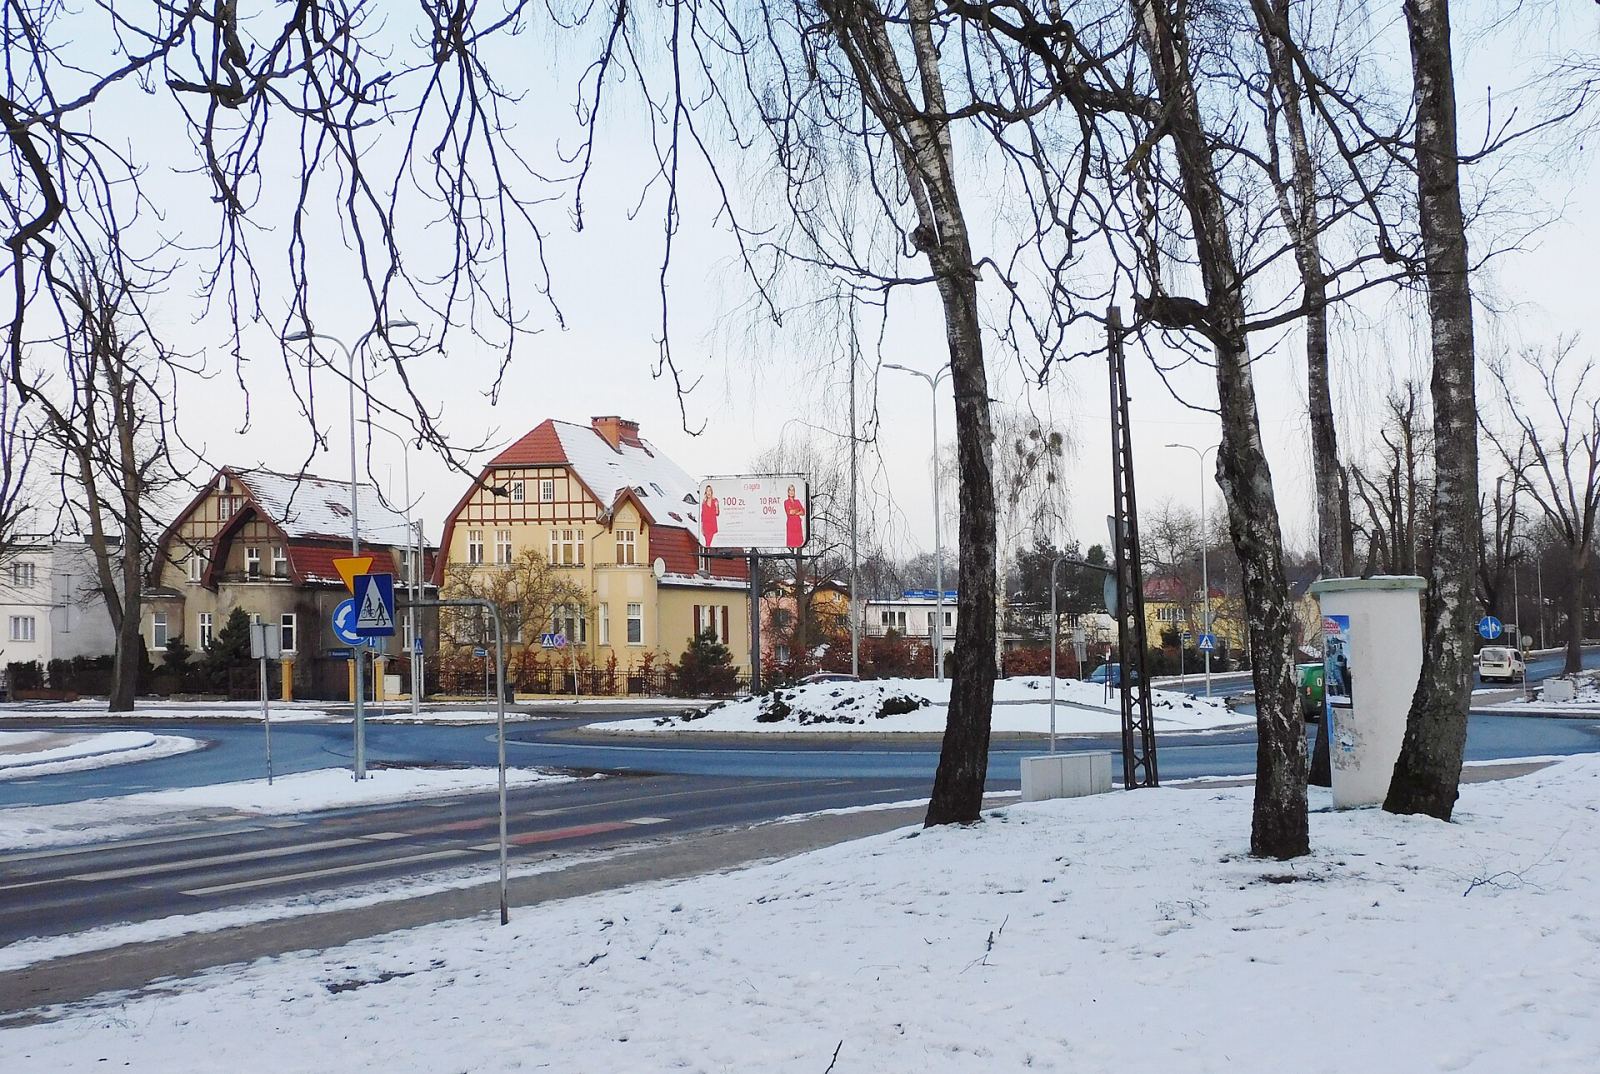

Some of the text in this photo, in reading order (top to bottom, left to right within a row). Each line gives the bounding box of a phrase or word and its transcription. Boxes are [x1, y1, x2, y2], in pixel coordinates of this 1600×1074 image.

[723, 497, 737, 506] 100
[760, 497, 780, 505] 10 RAT
[763, 506, 776, 515] 0%
